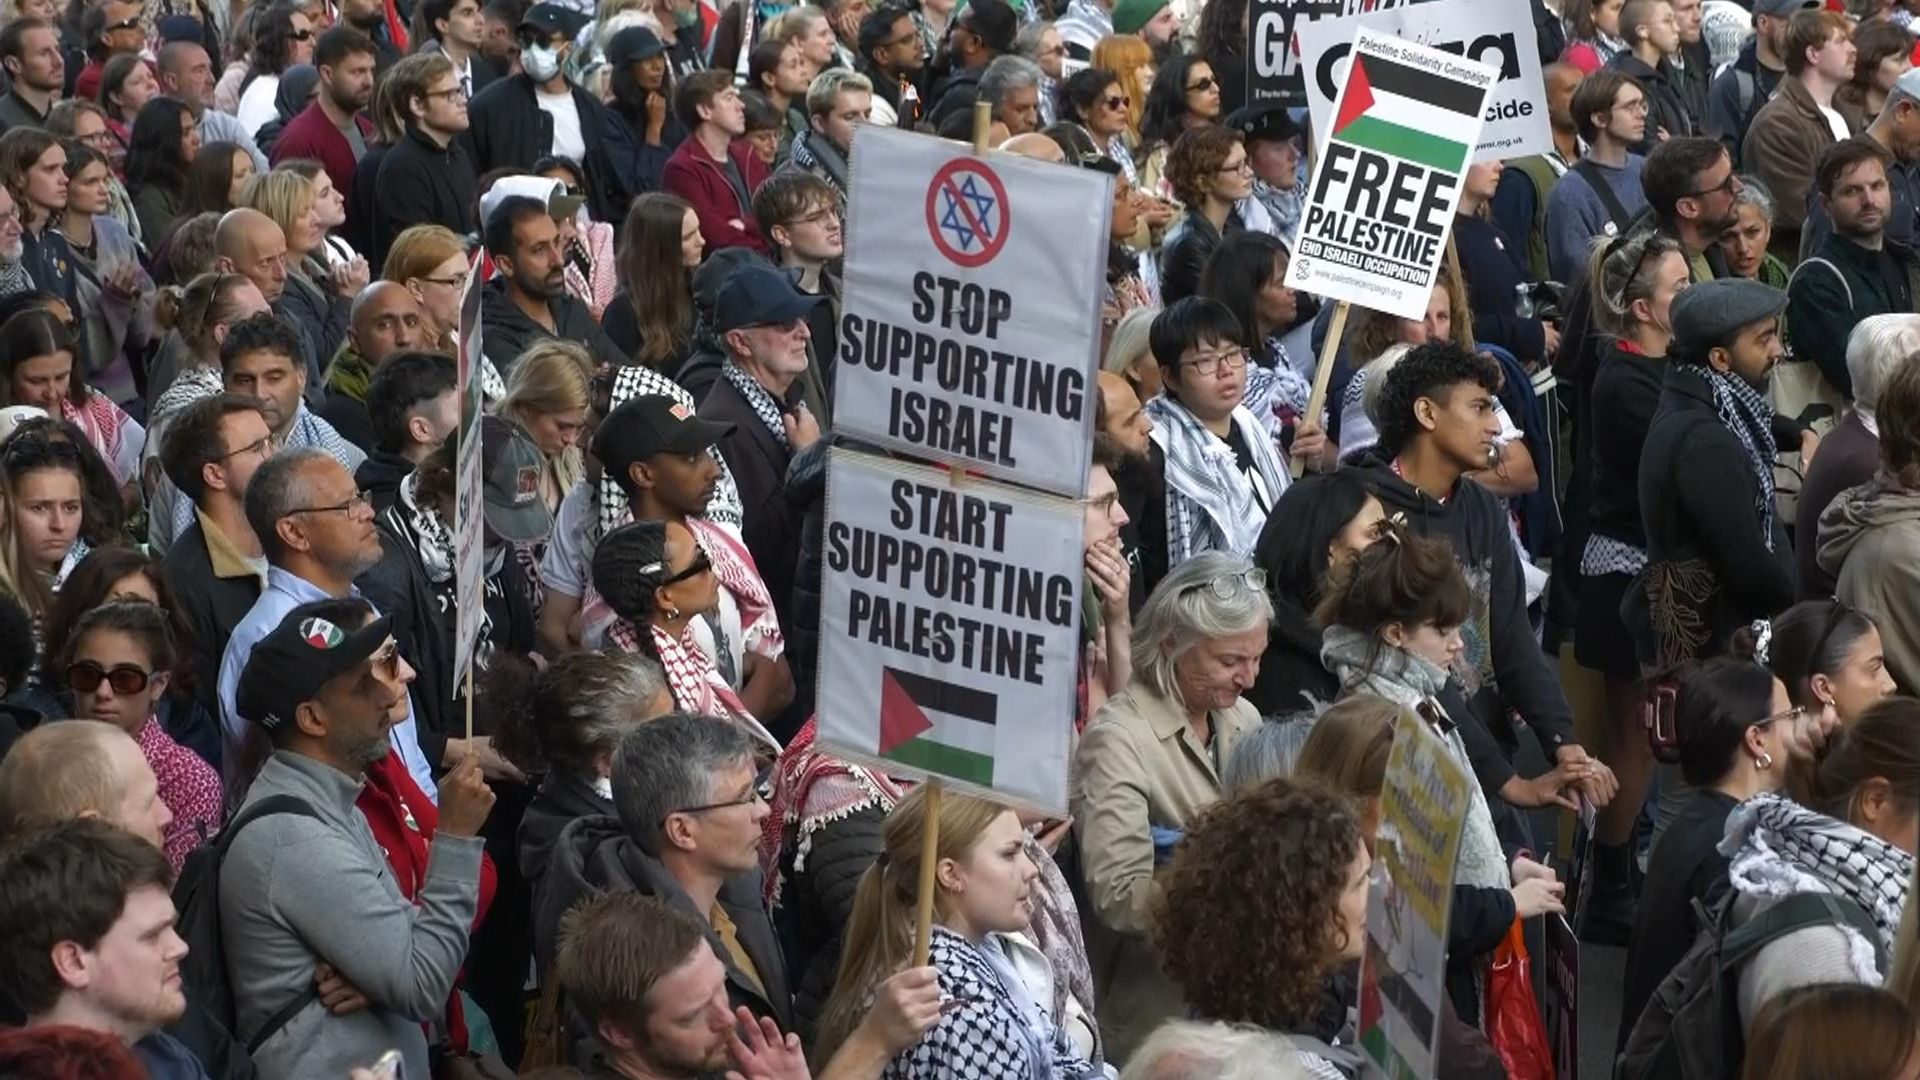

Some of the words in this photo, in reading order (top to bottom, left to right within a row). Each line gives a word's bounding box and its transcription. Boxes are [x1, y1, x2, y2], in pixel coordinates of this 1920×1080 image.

[1358, 36, 1399, 58] Palestine
[1401, 48, 1443, 73] Solidarity
[1444, 62, 1491, 86] Campaign
[1485, 99, 1533, 122] cide
[1312, 142, 1458, 237] FREE
[1300, 239, 1322, 257] END
[1323, 245, 1364, 268] ISRAELI
[1364, 256, 1429, 286] OCCUPATION
[1304, 205, 1440, 267] PALESTINE
[912, 271, 1012, 339] STOP
[840, 313, 1084, 422] SUPPORTING
[889, 387, 1015, 468] ISRAEL
[890, 479, 1012, 552] START
[828, 521, 1072, 627] SUPPORTING
[848, 589, 1045, 685] PALESTINE
